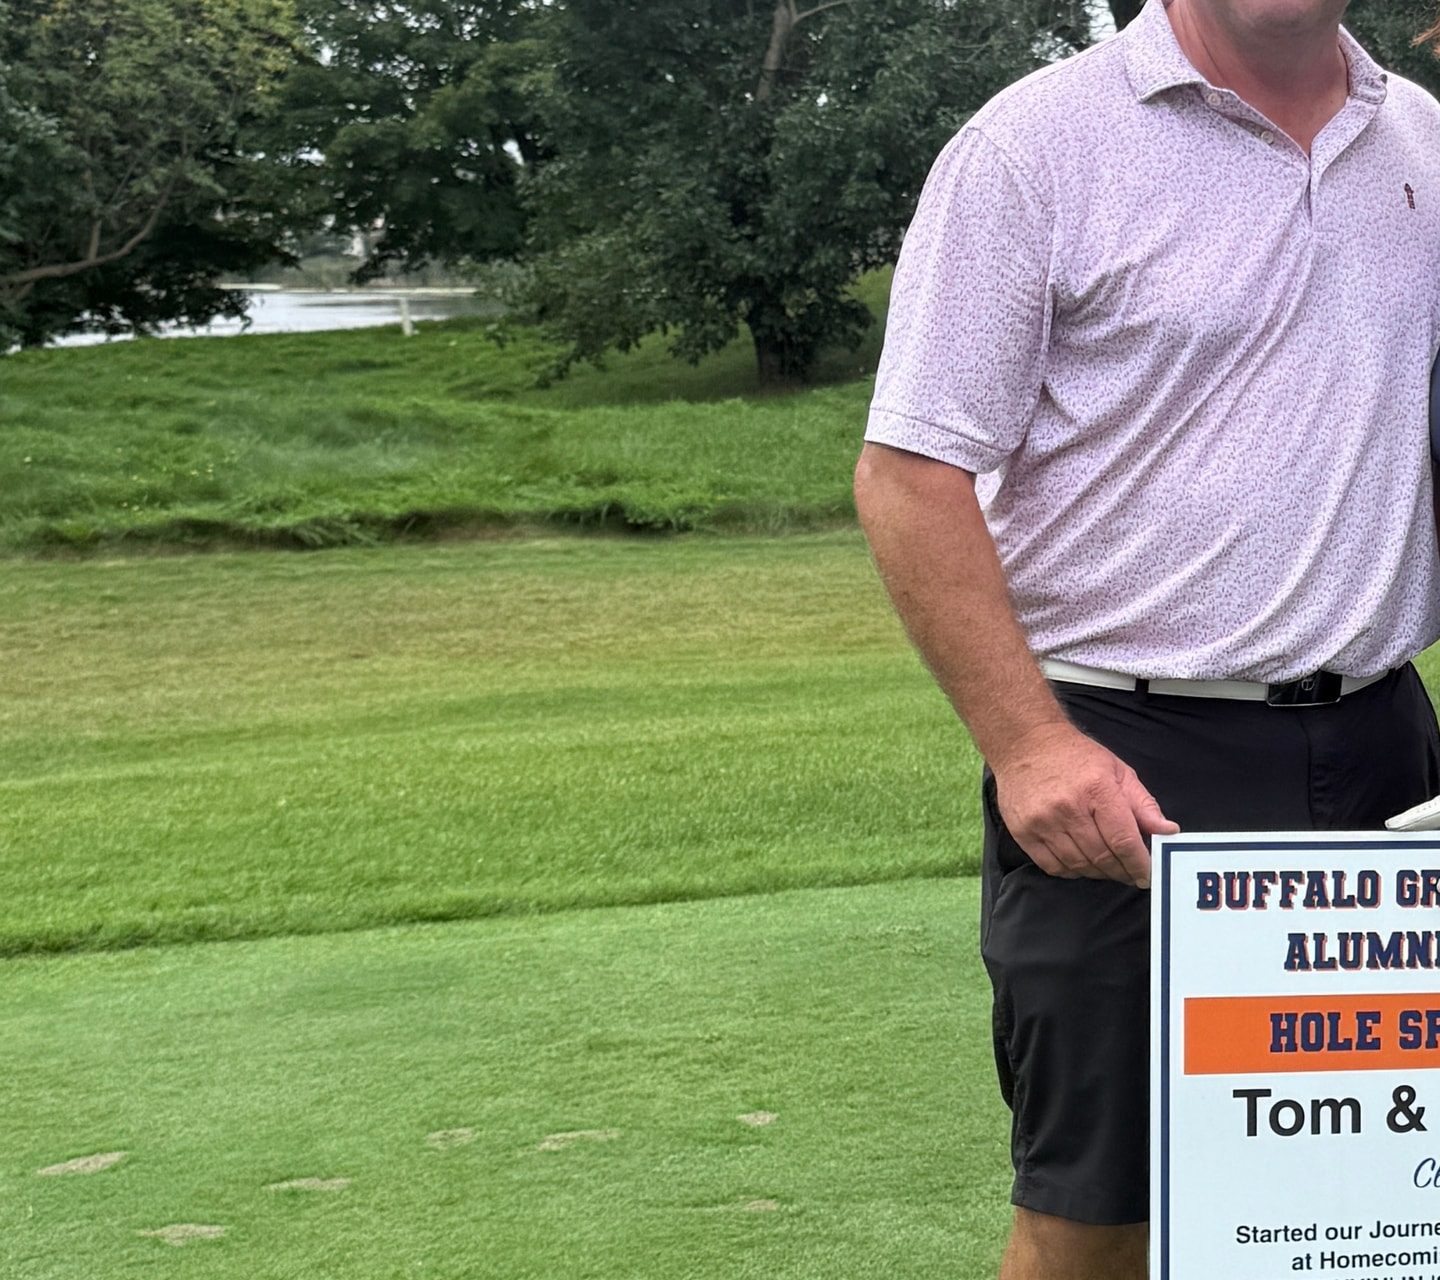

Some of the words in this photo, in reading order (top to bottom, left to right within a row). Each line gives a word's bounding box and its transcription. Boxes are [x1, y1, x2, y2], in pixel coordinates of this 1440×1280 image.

[1197, 870, 1381, 910] BUFFALO
[1270, 1011, 1381, 1052] HOLE
[1233, 1089, 1361, 1137] Tom
[1386, 1085, 1427, 1133] &
[1236, 1223, 1317, 1244] Started
[1325, 1226, 1362, 1240] our
[1292, 1253, 1312, 1270] at
